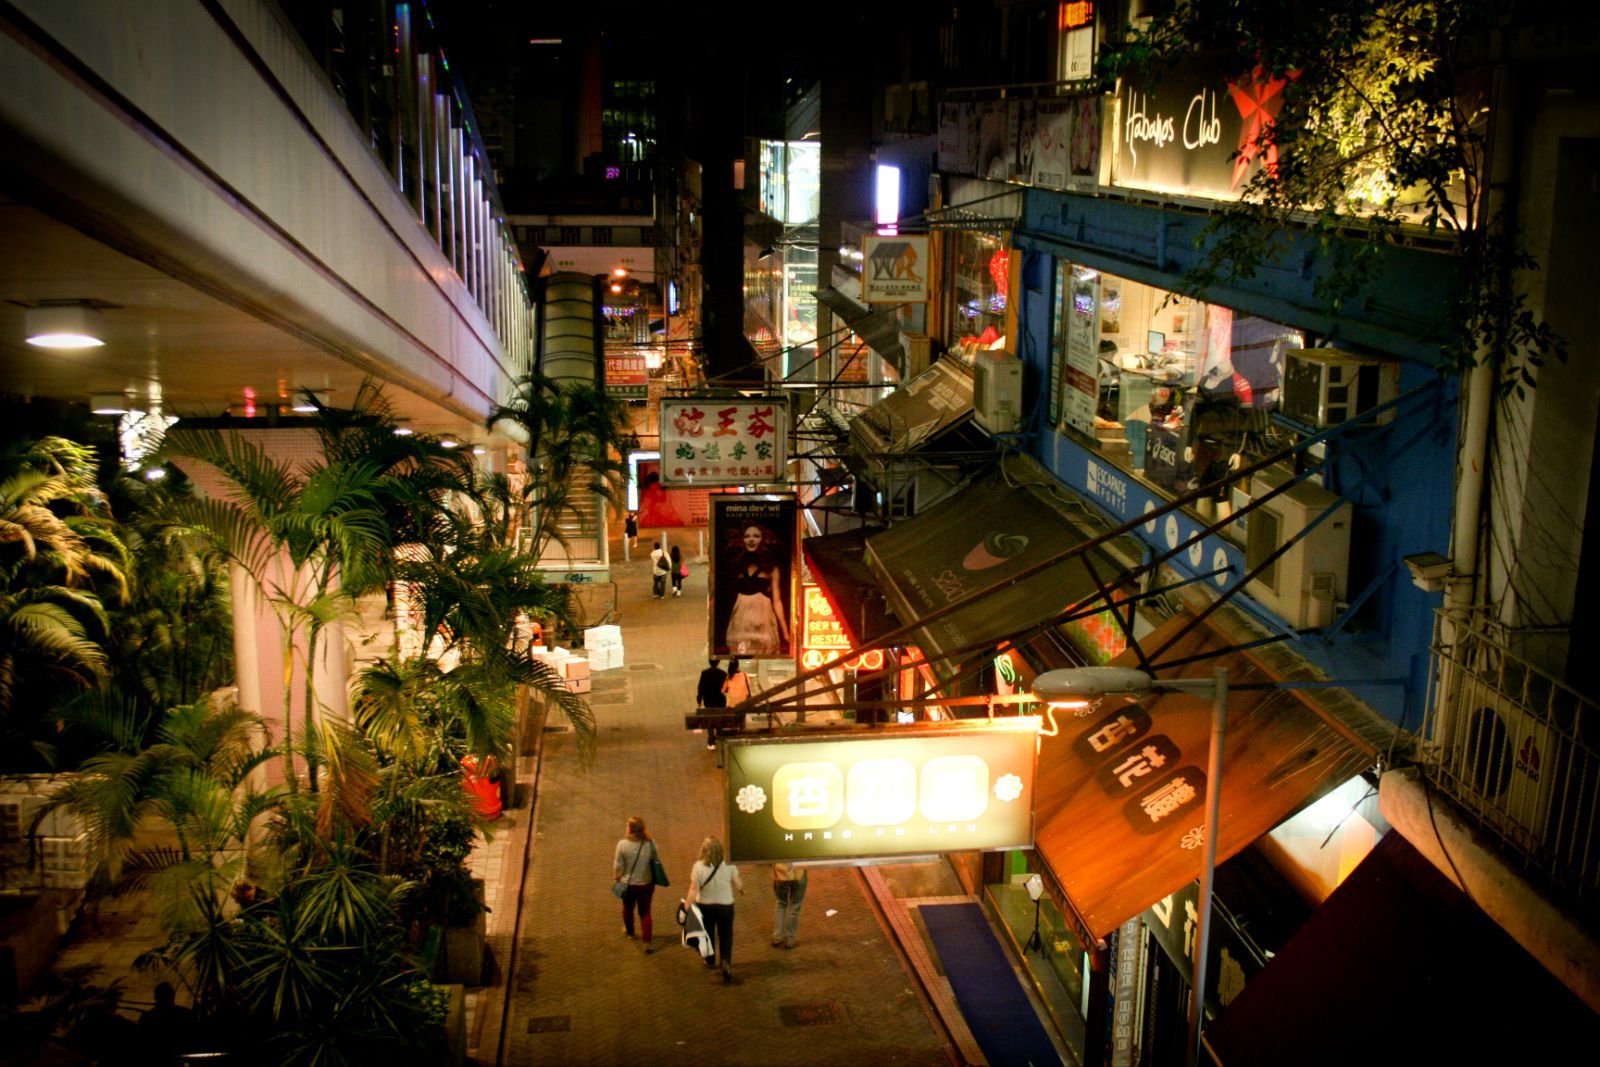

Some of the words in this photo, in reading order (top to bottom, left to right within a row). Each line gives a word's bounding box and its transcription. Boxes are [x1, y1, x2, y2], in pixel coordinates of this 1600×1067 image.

[1126, 86, 1174, 180] Habanos
[1183, 87, 1222, 150] Club
[674, 406, 775, 438] 蛇王芬
[1096, 484, 1126, 514] SPORTS
[1097, 466, 1127, 500] ESCAPADE
[726, 503, 748, 513] mina
[809, 621, 830, 631] SER
[1087, 714, 1197, 823] 杏花樓
